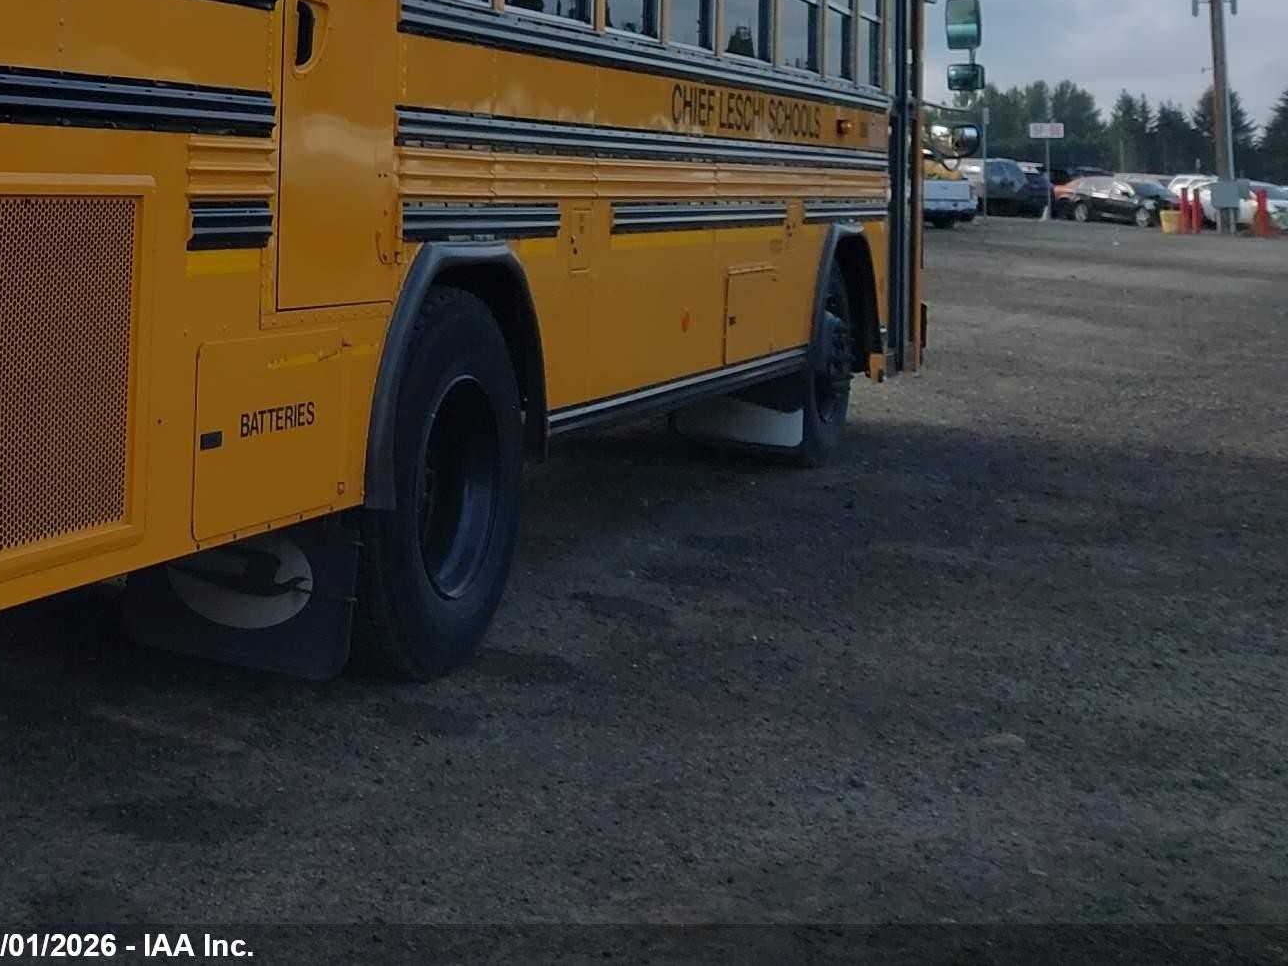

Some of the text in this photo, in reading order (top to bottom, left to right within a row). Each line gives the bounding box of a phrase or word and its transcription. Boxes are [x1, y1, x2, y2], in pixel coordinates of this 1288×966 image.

[671, 83, 716, 126] CHIEF
[768, 97, 822, 139] SCHOOLS
[240, 401, 315, 438] BATTERIES
